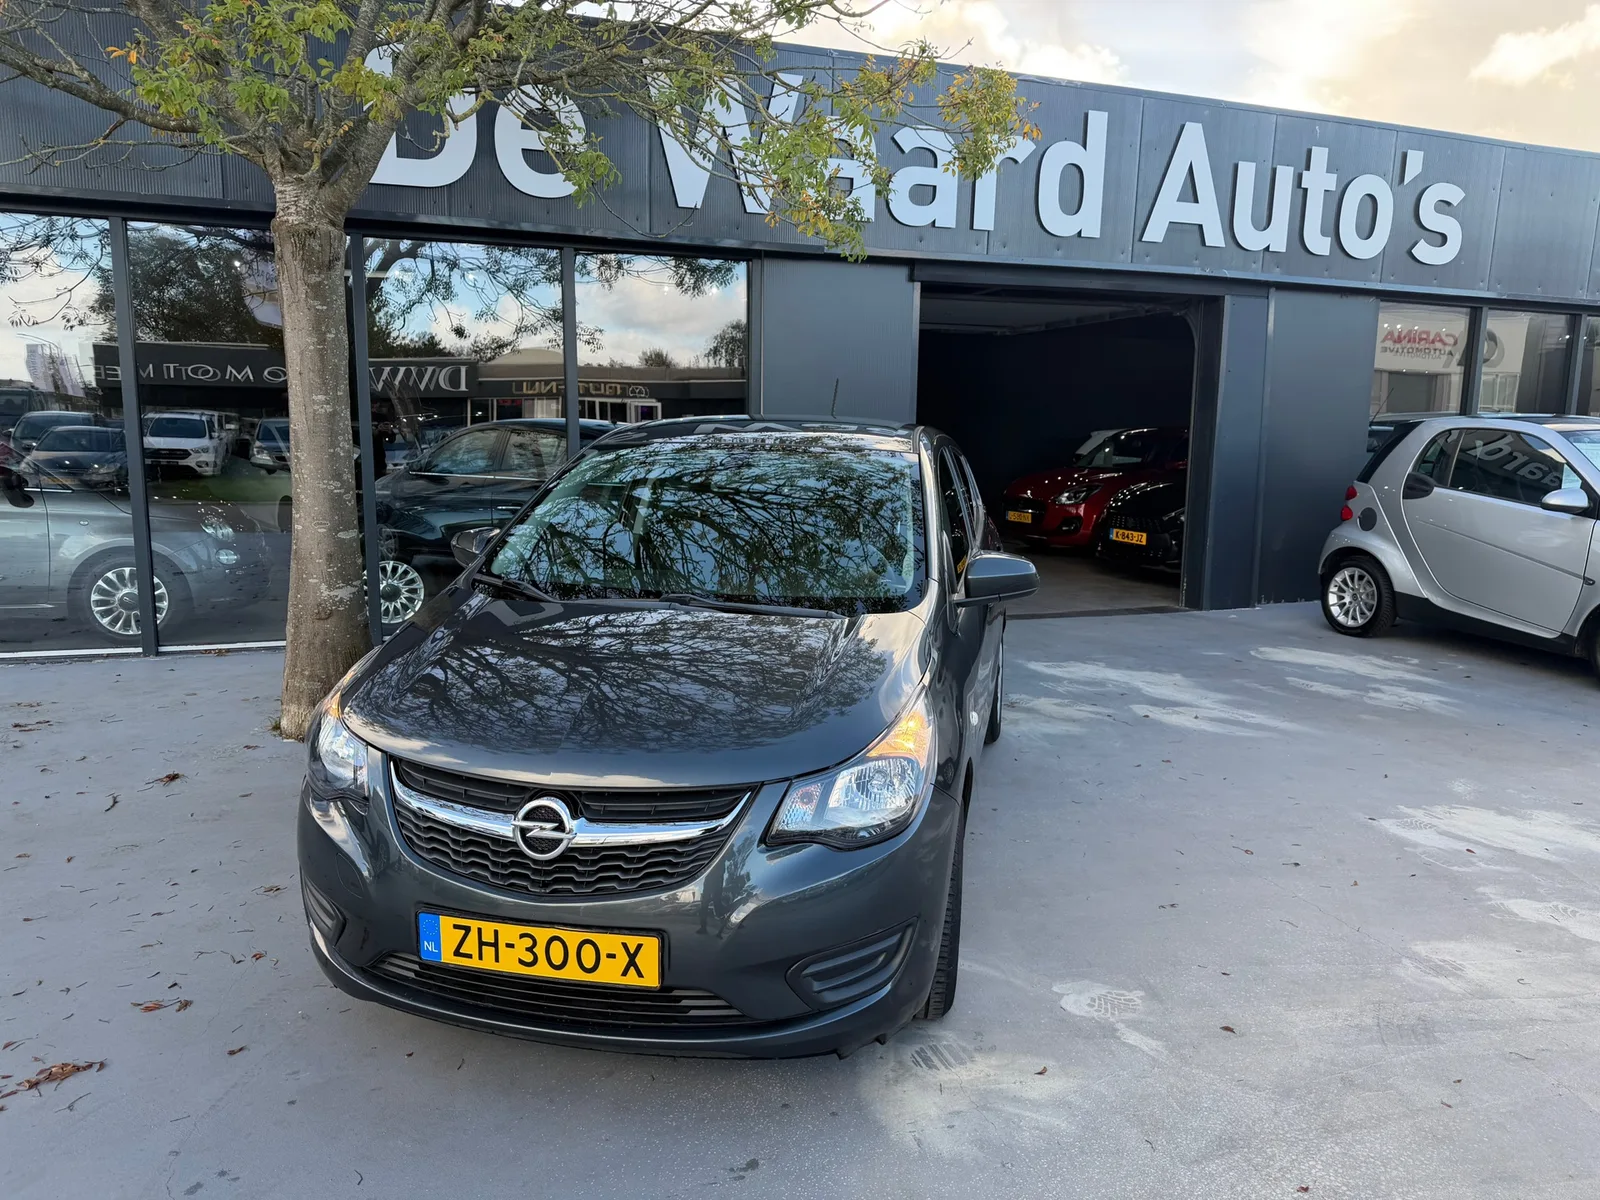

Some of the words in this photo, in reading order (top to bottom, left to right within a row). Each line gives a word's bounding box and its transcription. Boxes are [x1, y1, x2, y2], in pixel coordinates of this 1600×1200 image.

[643, 58, 1108, 238] Waard
[1141, 121, 1466, 265] Auto's
[1115, 529, 1144, 544] K-843-JZ
[424, 940, 438, 953] NL
[452, 923, 645, 979] ZH-300-X
